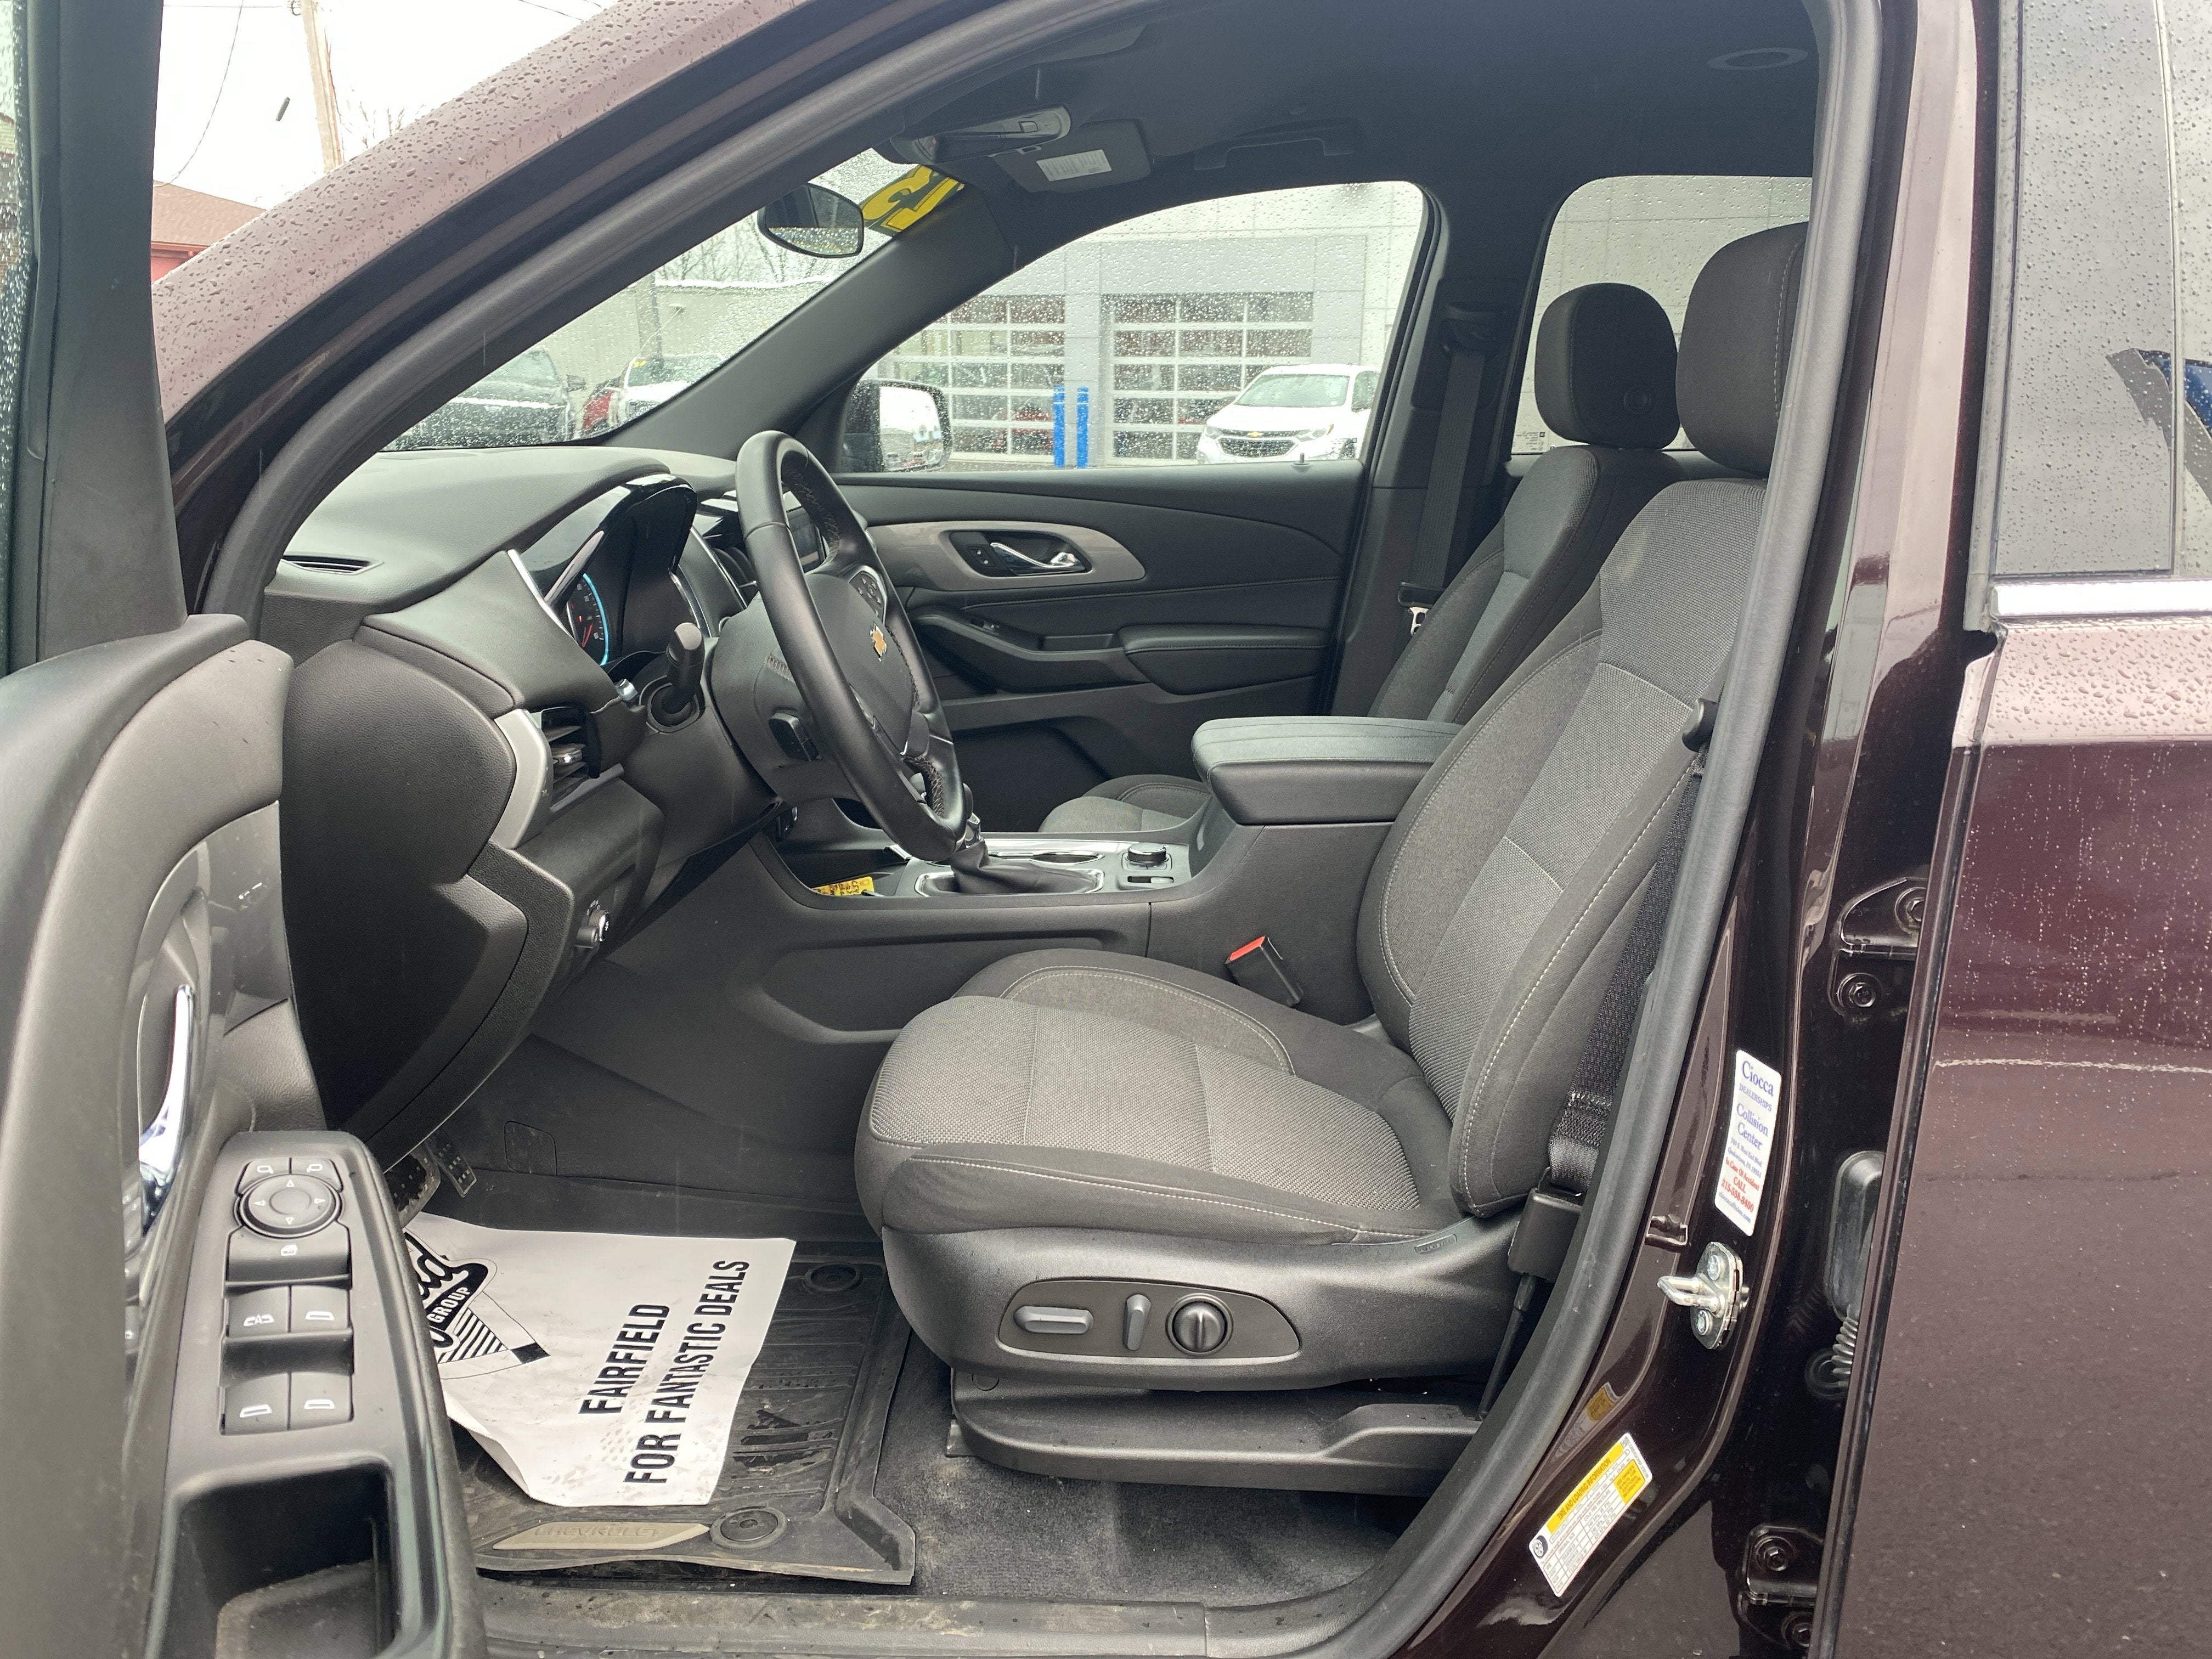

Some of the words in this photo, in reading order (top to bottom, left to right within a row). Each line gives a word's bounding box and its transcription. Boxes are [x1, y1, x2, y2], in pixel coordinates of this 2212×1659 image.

[1741, 1060, 1774, 1097] Ciocca
[1739, 1083, 1773, 1112] DEALERSHIPS
[1736, 1103, 1769, 1137] Collision
[1737, 1122, 1763, 1150] Center
[1725, 1156, 1730, 1165] In
[1729, 1160, 1739, 1173] Case
[1743, 1172, 1759, 1191] Accident
[1733, 1175, 1747, 1193] CALL
[426, 1287, 471, 1323] GROUP
[699, 1260, 750, 1316] DEALS
[578, 1304, 670, 1414] FAIRFIELD
[645, 1323, 726, 1423] FANTASTIC
[623, 1433, 682, 1484] FOR
[1557, 1508, 1566, 1520] TIRE
[1564, 1498, 1574, 1512] AND
[1572, 1482, 1588, 1503] LOADING
[1587, 1457, 1611, 1487] INFORMATION
[534, 1527, 659, 1537] CHEVROLET
